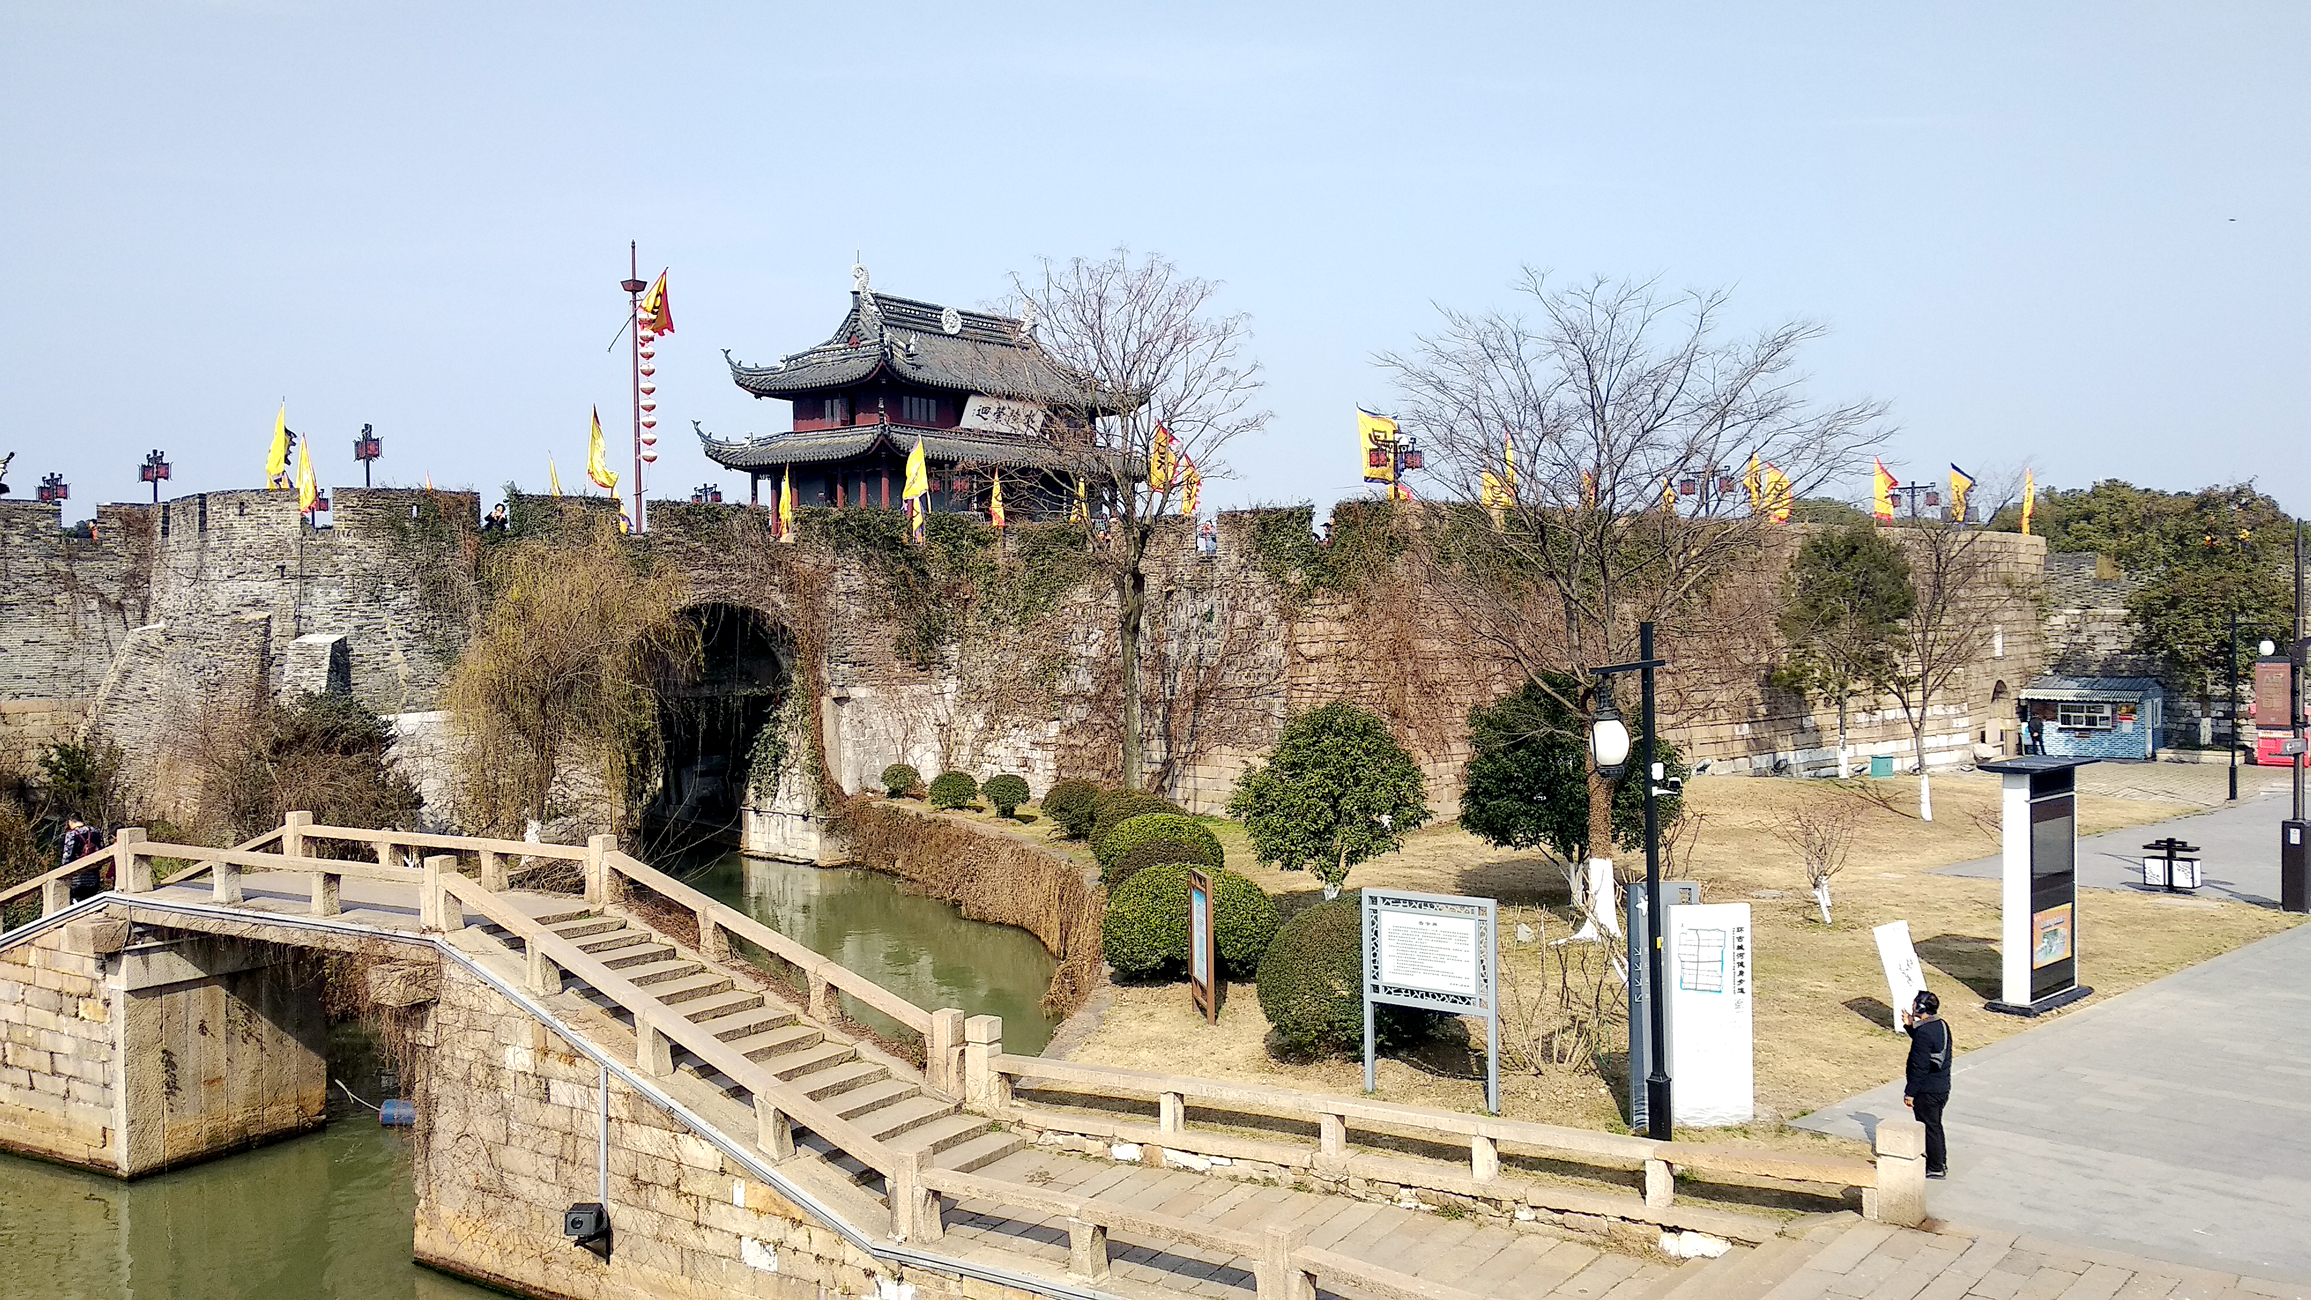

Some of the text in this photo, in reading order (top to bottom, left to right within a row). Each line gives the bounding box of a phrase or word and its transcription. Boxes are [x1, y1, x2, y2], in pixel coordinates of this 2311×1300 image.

[1736, 926, 1746, 994] 环古城河健身步道
